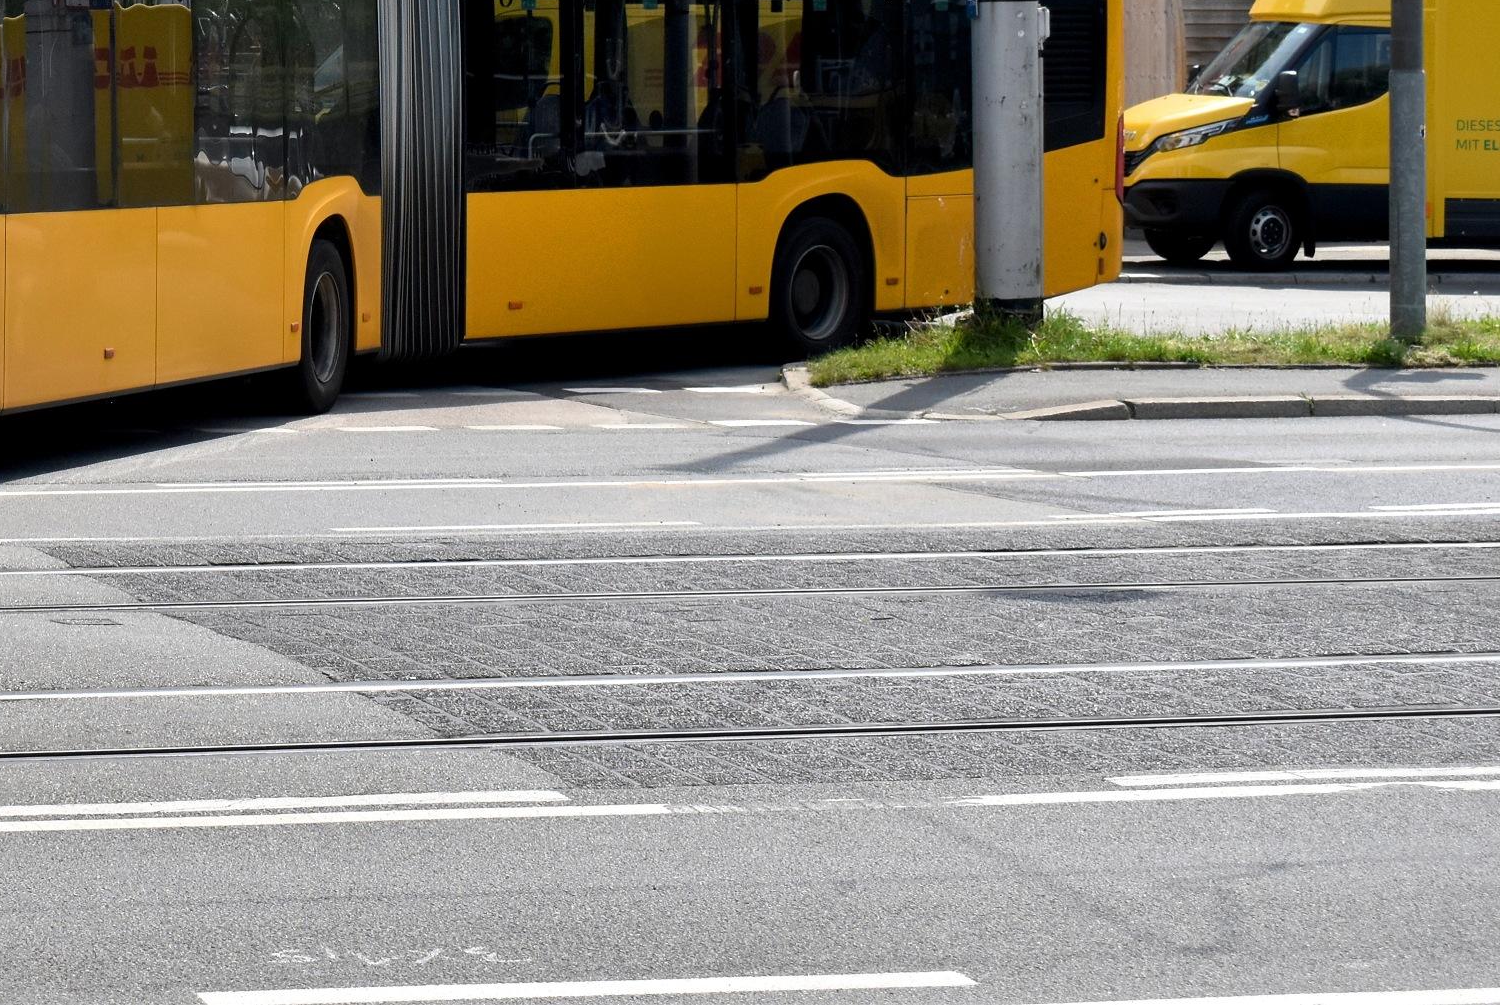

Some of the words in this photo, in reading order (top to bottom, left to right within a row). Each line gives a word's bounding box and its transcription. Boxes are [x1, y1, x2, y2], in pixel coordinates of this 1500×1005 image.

[1456, 119, 1500, 132] DIESES
[1456, 140, 1480, 151] MIT
[1484, 140, 1500, 151] EL
